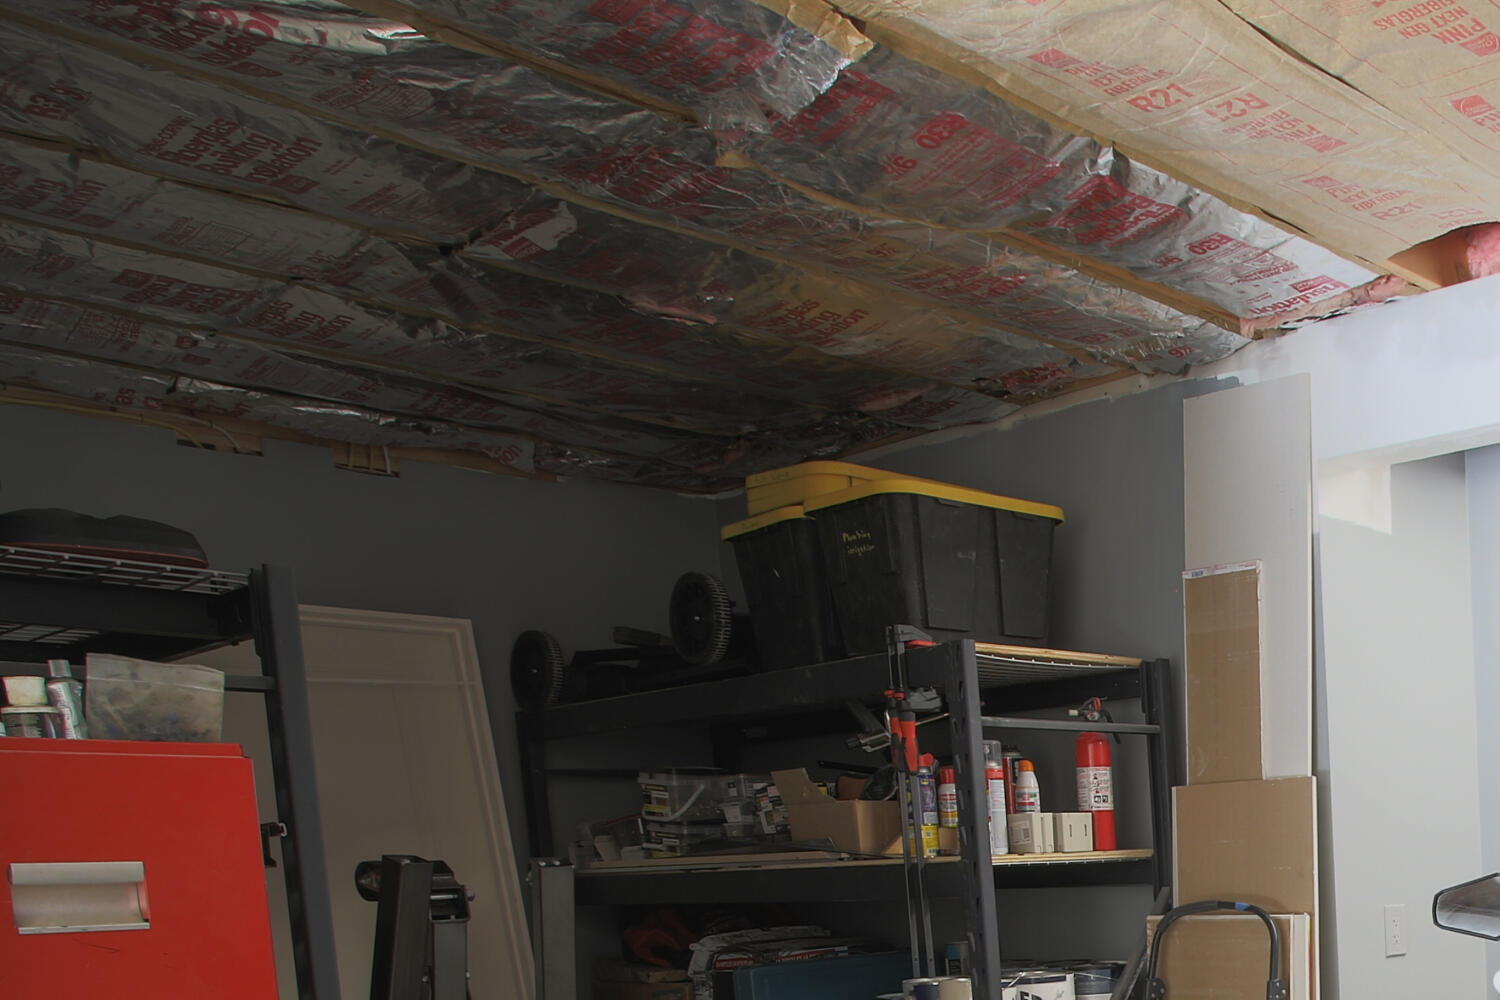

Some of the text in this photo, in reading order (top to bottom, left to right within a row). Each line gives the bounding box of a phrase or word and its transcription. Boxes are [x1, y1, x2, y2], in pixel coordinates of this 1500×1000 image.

[1397, 6, 1469, 40] NEXT GEN
[1431, 17, 1487, 45] PINK
[1126, 82, 1194, 113] R21
[1204, 92, 1271, 122] R21
